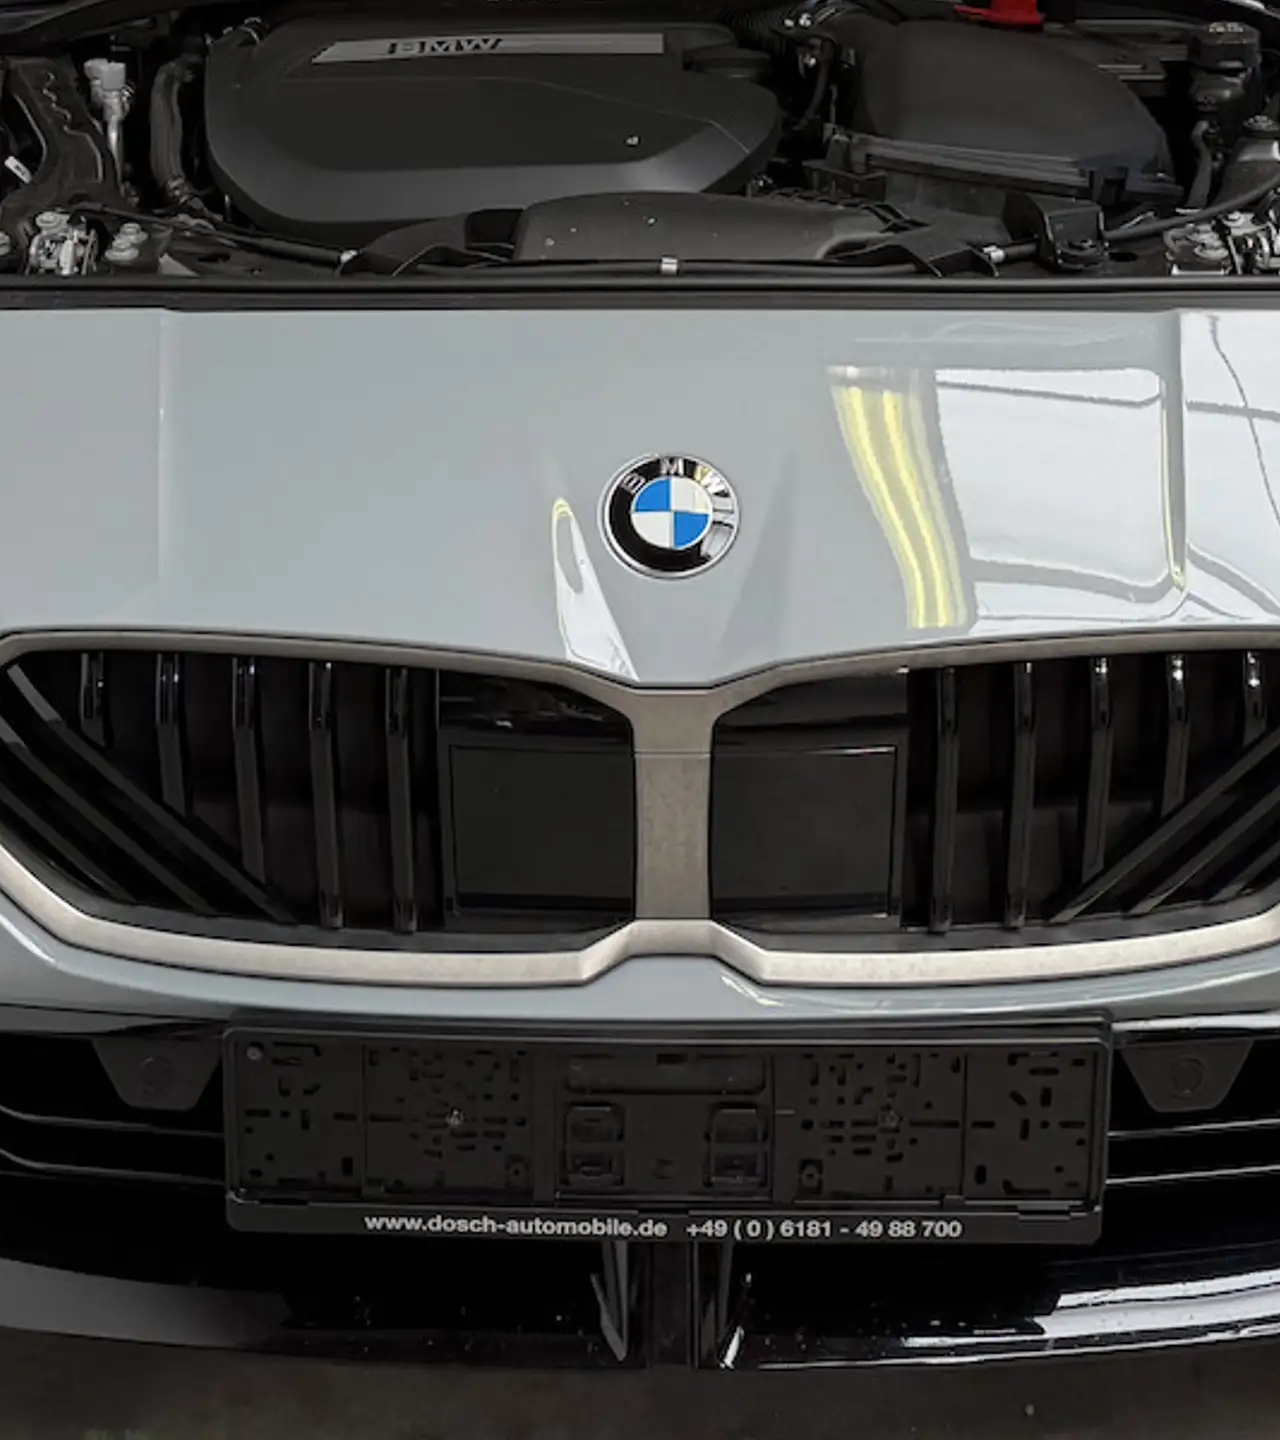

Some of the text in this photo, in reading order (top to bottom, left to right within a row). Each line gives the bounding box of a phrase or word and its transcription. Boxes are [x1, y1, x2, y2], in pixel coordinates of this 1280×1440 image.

[387, 37, 503, 56] BMW
[620, 458, 733, 501] BMW
[364, 1214, 668, 1238] www.dosch-automobile.de
[686, 1219, 728, 1238] +49
[780, 1219, 831, 1238] 6181
[855, 1220, 883, 1238] 49
[888, 1220, 916, 1238] 88
[921, 1220, 962, 1239] 700
